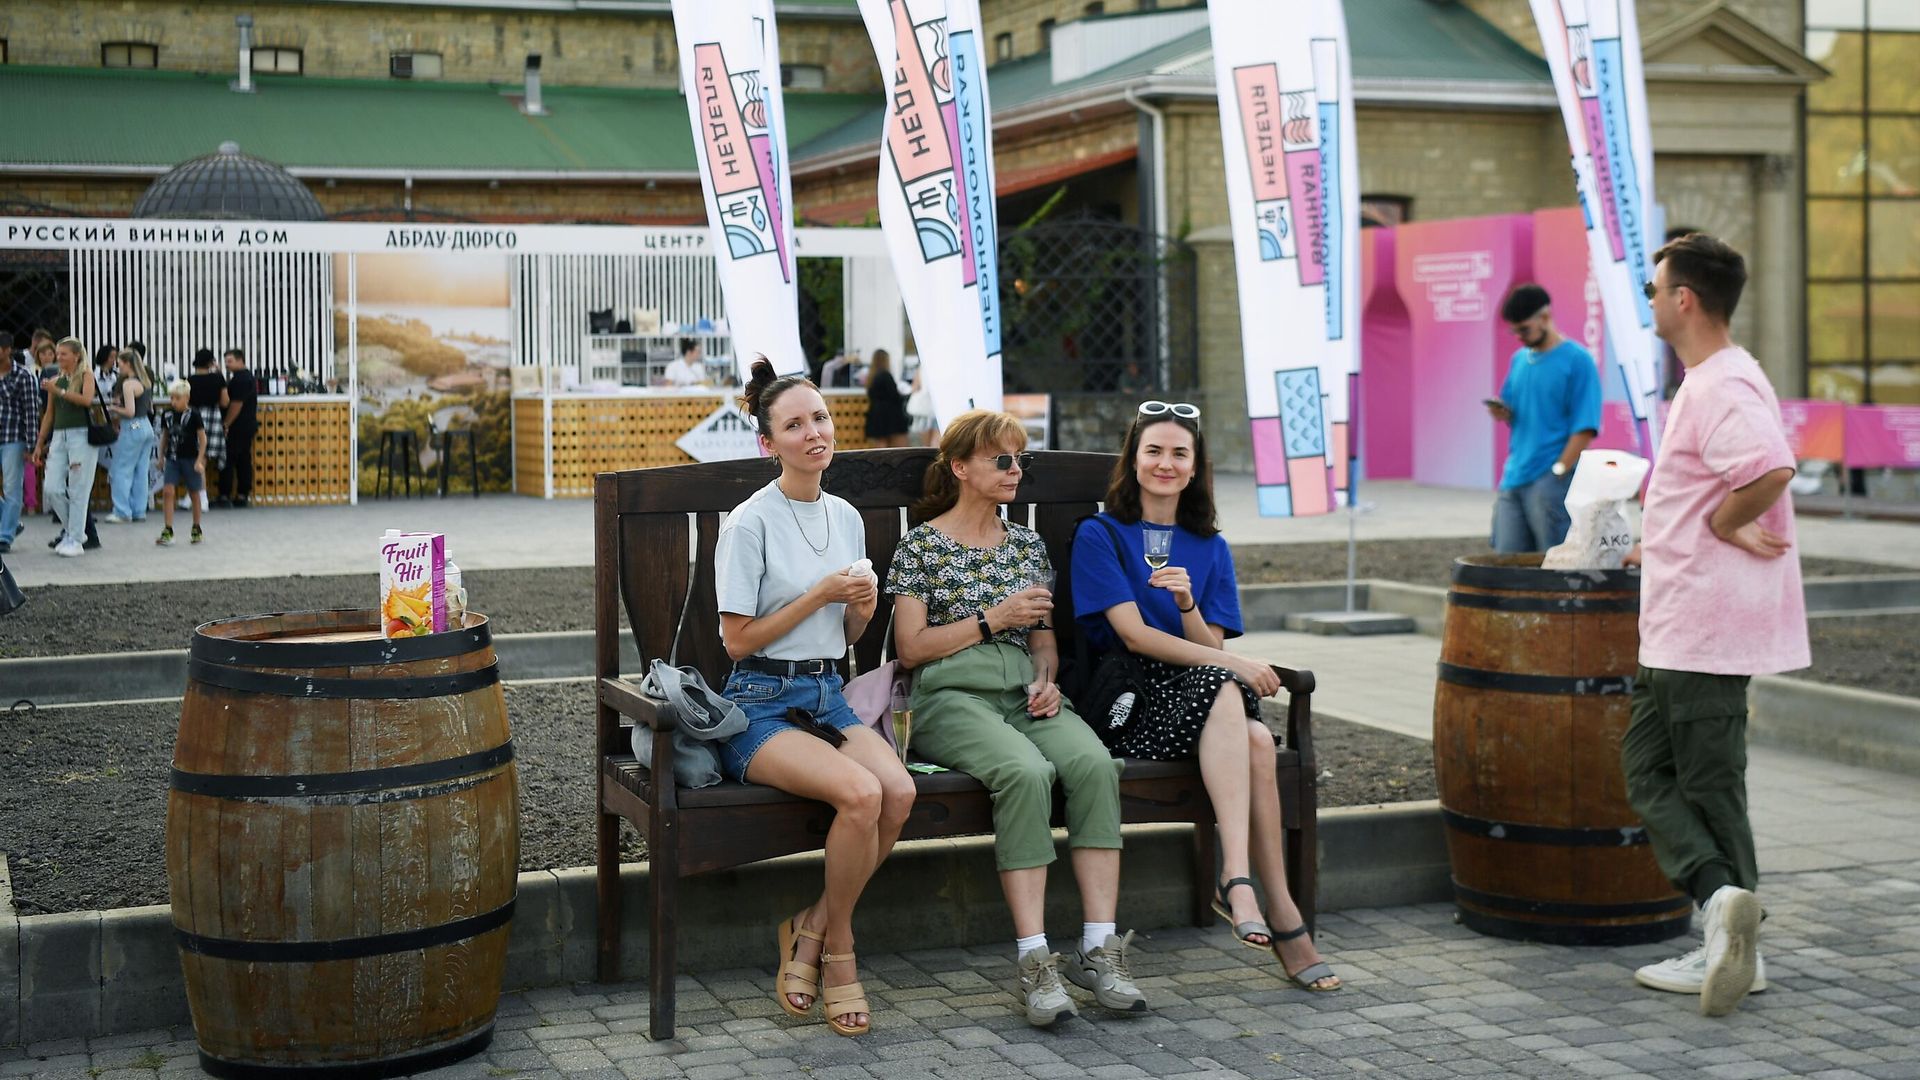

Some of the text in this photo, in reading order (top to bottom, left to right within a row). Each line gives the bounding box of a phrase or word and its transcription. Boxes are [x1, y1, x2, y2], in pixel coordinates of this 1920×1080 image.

[8, 223, 288, 246] РУССКИЙ ВИННЫЙ ДОМ
[644, 235, 705, 249] ЦЕНТР
[382, 542, 428, 563] Fruit
[394, 562, 424, 582] Hit
[1109, 702, 1119, 715] THE
[1109, 704, 1125, 729] NORTH
[1117, 706, 1131, 726] FACE
